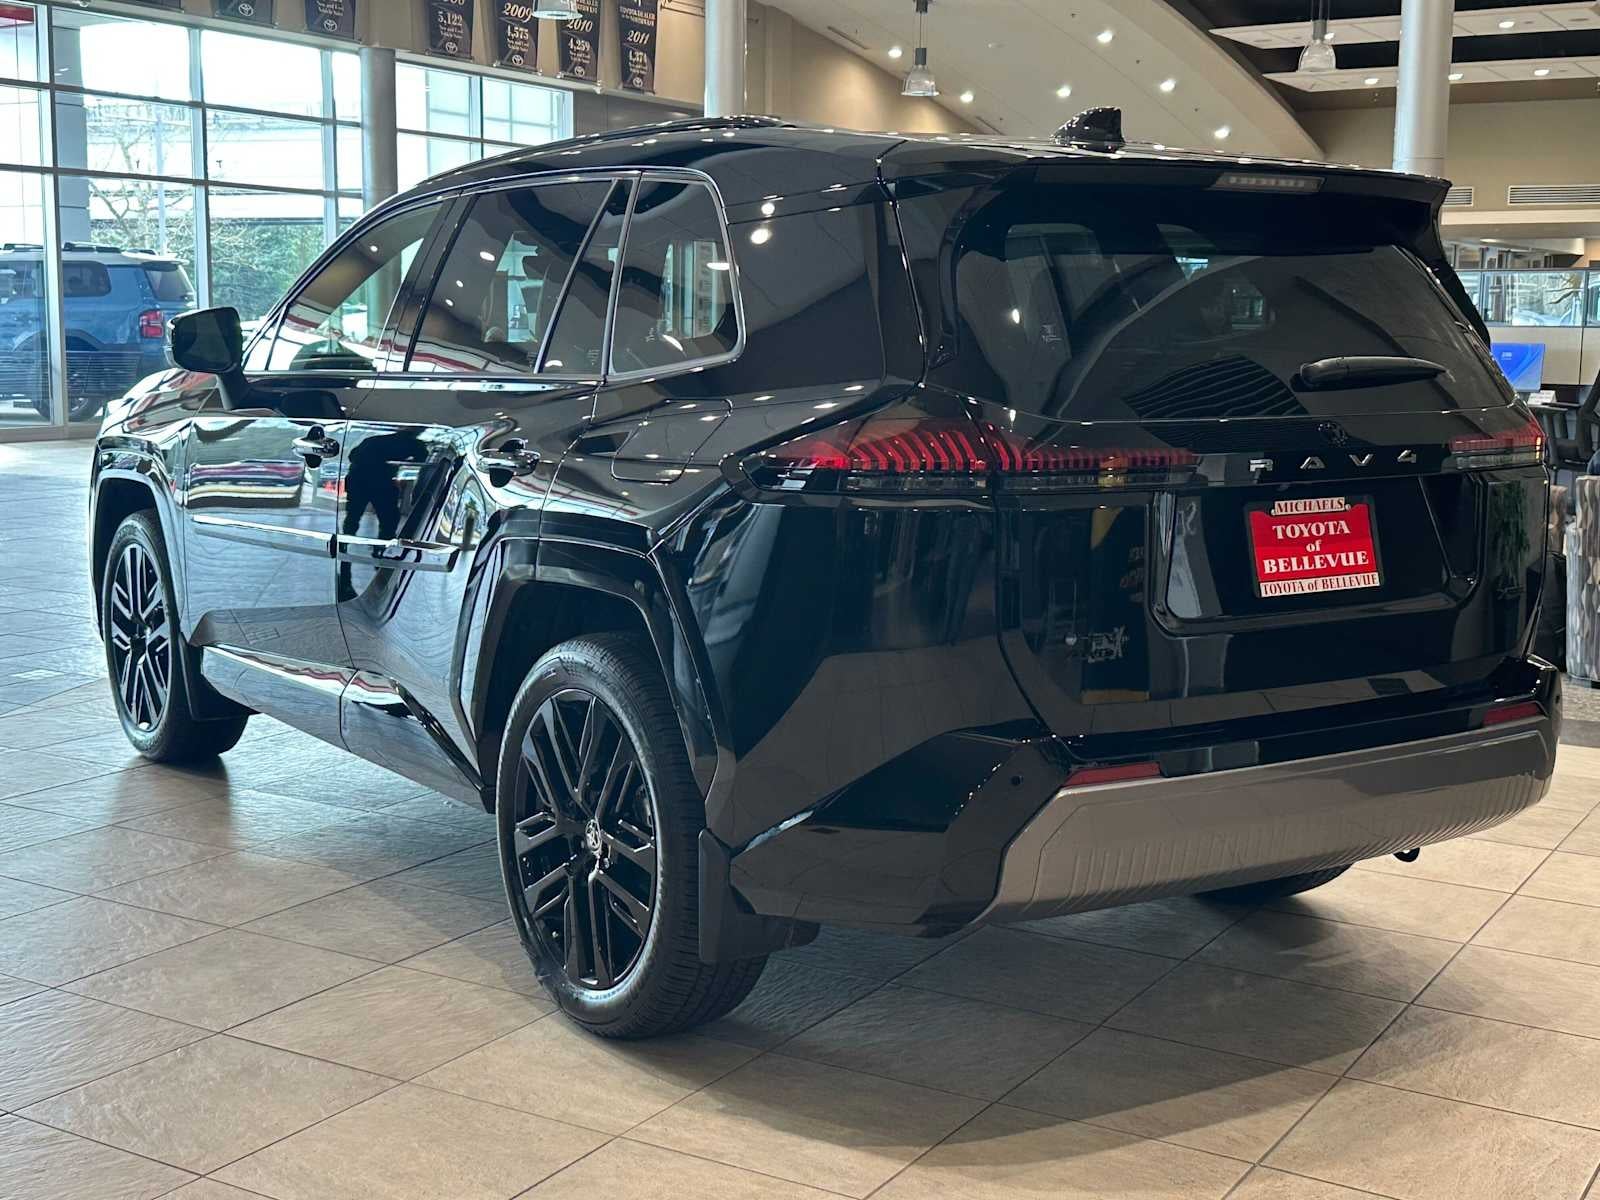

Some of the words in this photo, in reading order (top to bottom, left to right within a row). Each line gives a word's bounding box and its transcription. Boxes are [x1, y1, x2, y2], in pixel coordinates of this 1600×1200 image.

[438, 11, 463, 26] 5,122
[503, 2, 532, 23] 2009
[567, 19, 593, 32] 2010
[568, 38, 590, 51] 4,259
[627, 31, 650, 44] 2011
[1249, 449, 1417, 472] RAV4
[1276, 498, 1345, 514] MICHAELS
[1272, 520, 1350, 539] TOYOTA
[1306, 540, 1323, 552] of
[1263, 551, 1369, 574] BELLEVUE
[1262, 580, 1304, 596] TOYOTA
[1307, 580, 1320, 592] of
[1322, 574, 1379, 590] BELLEVUE
